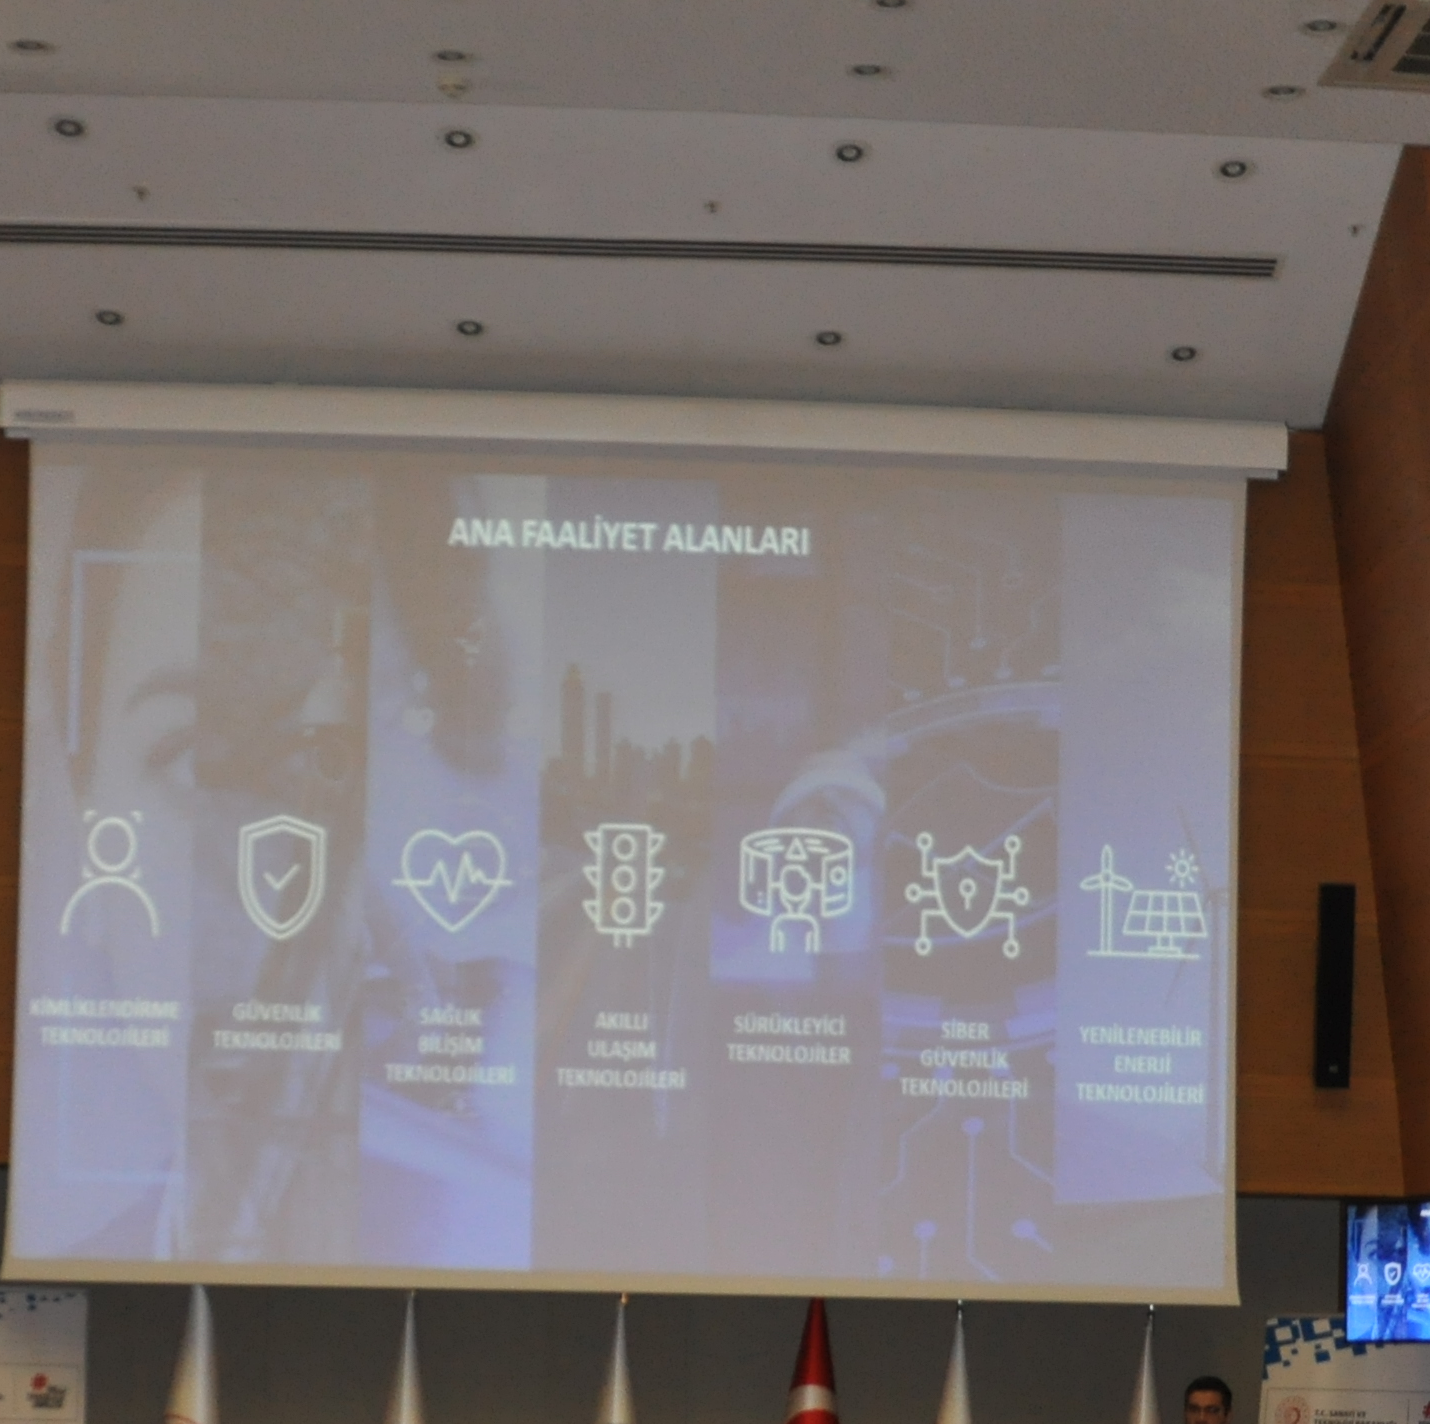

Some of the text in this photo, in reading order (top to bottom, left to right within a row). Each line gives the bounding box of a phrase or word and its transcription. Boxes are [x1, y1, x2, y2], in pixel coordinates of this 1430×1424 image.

[448, 514, 811, 556] ANA FAALİYET ALANLARI
[232, 1000, 321, 1023] GÜVENLİK
[419, 1003, 482, 1026] SAĞLIK
[594, 1010, 648, 1031] AKILLI
[733, 1011, 847, 1036] SÜRÜKLEYİCİ
[941, 1017, 990, 1041] SİBER
[1078, 1022, 1202, 1048] YENİLENEBİLİR
[587, 1039, 657, 1062] ULAŞIM
[726, 1042, 851, 1065] TEKNOLOJİLER
[920, 1046, 1009, 1070] GÜVENLİK
[385, 1061, 516, 1086] TEKNOLOJİLERİ
[1114, 1051, 1172, 1075] ENERJİ
[556, 1066, 688, 1089] TEKNOLOJİLERİ
[899, 1075, 1030, 1099] TEKNOLOJİLERİ
[1076, 1080, 1205, 1106] TEKNOLOJİLERİ
